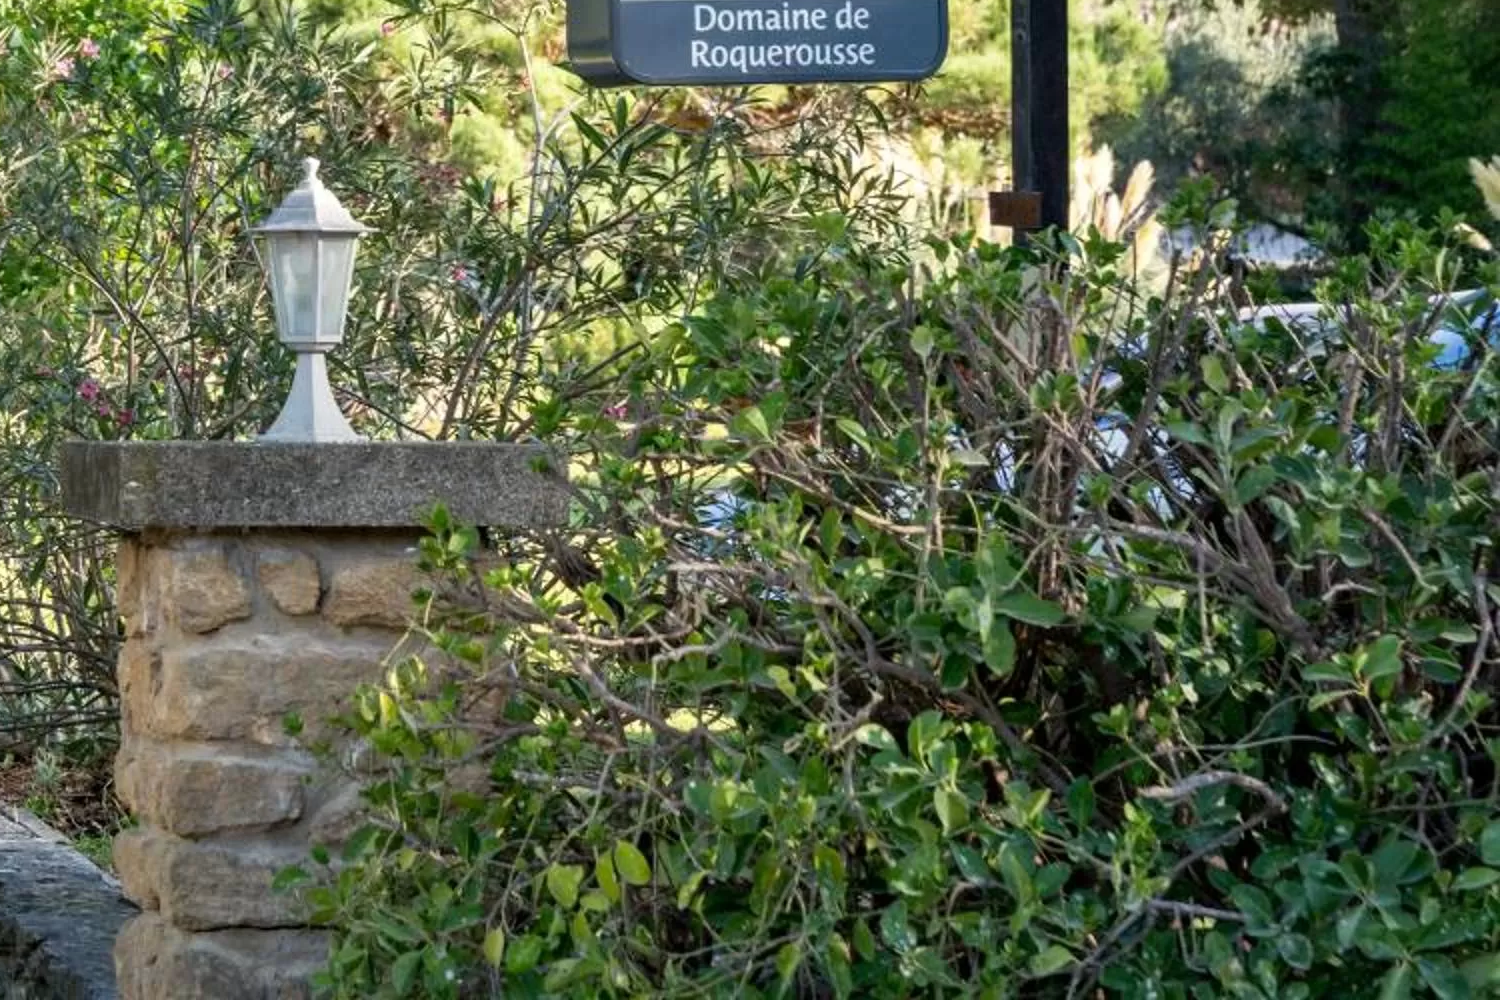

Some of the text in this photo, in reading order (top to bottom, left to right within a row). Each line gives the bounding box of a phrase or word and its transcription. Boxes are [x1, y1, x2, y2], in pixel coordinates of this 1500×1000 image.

[694, 1, 870, 33] Domaine de
[690, 40, 876, 73] Roquerousse
